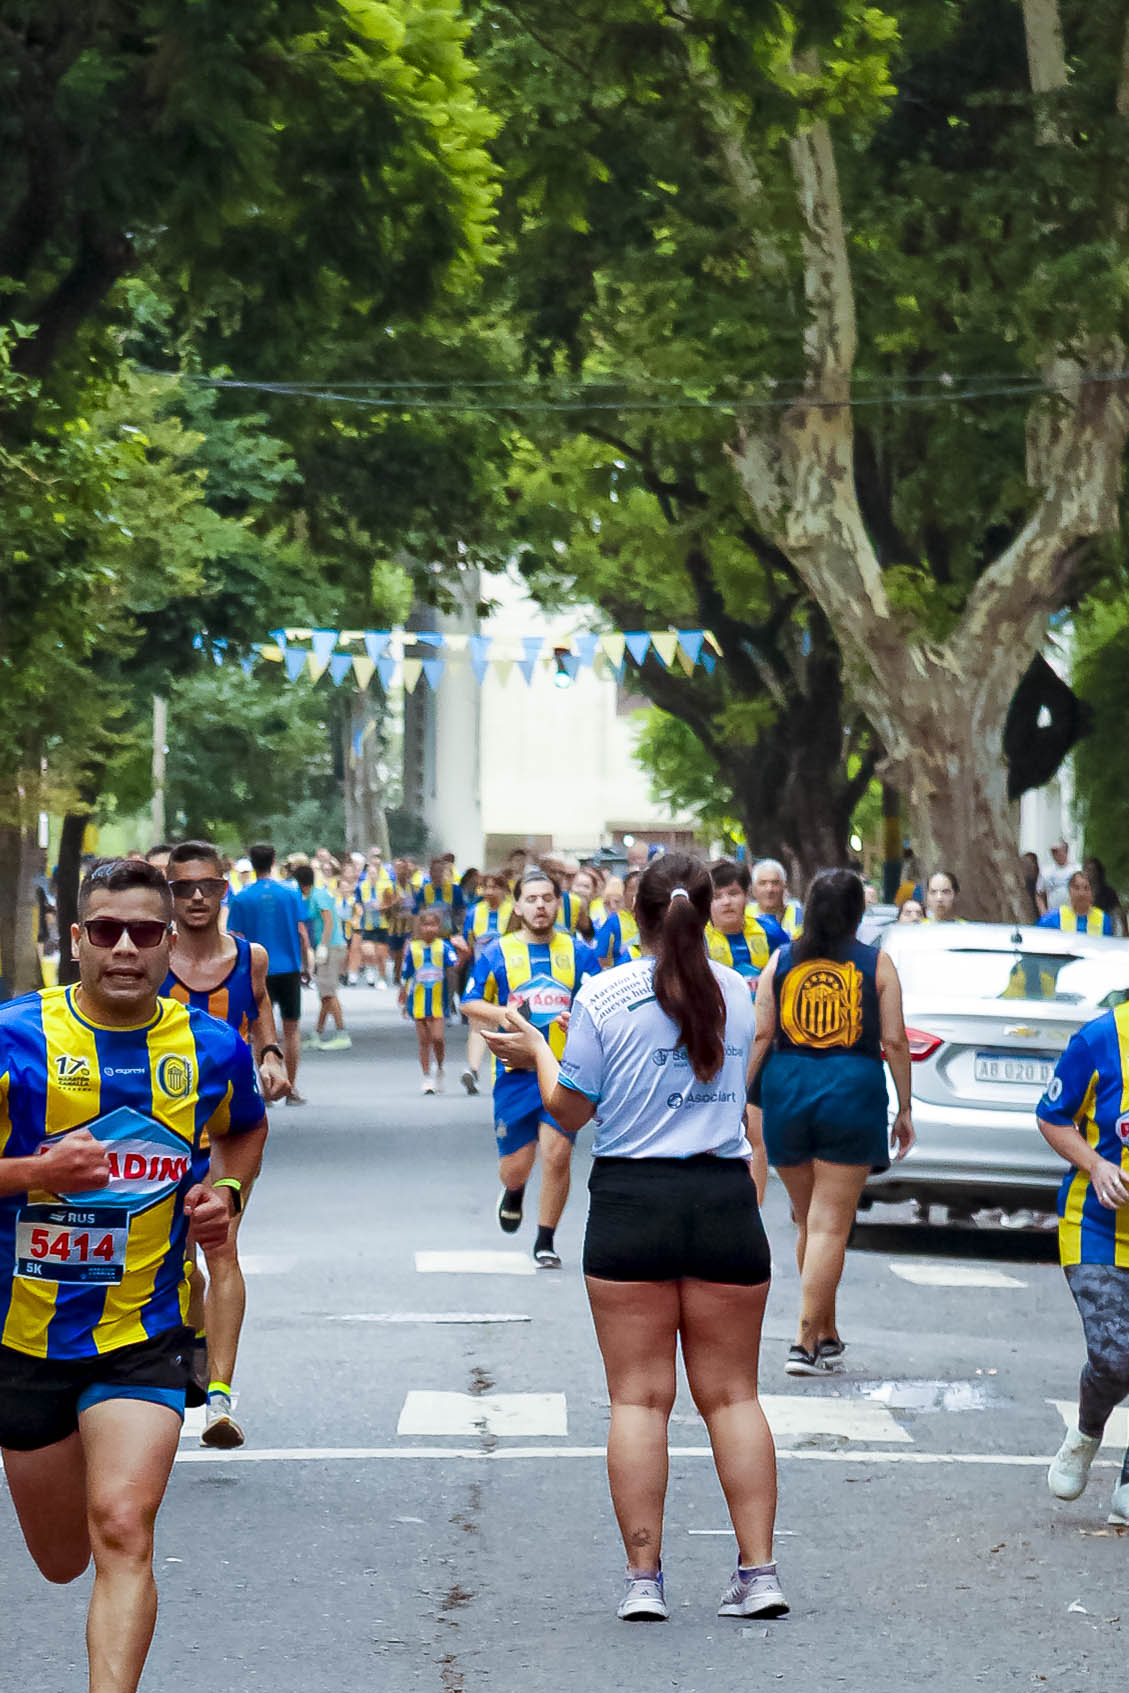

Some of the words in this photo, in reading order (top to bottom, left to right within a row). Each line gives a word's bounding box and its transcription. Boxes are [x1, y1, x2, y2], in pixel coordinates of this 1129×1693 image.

[68, 1212, 96, 1224] RUS
[30, 1228, 114, 1262] 5414
[26, 1262, 43, 1276] 5K
